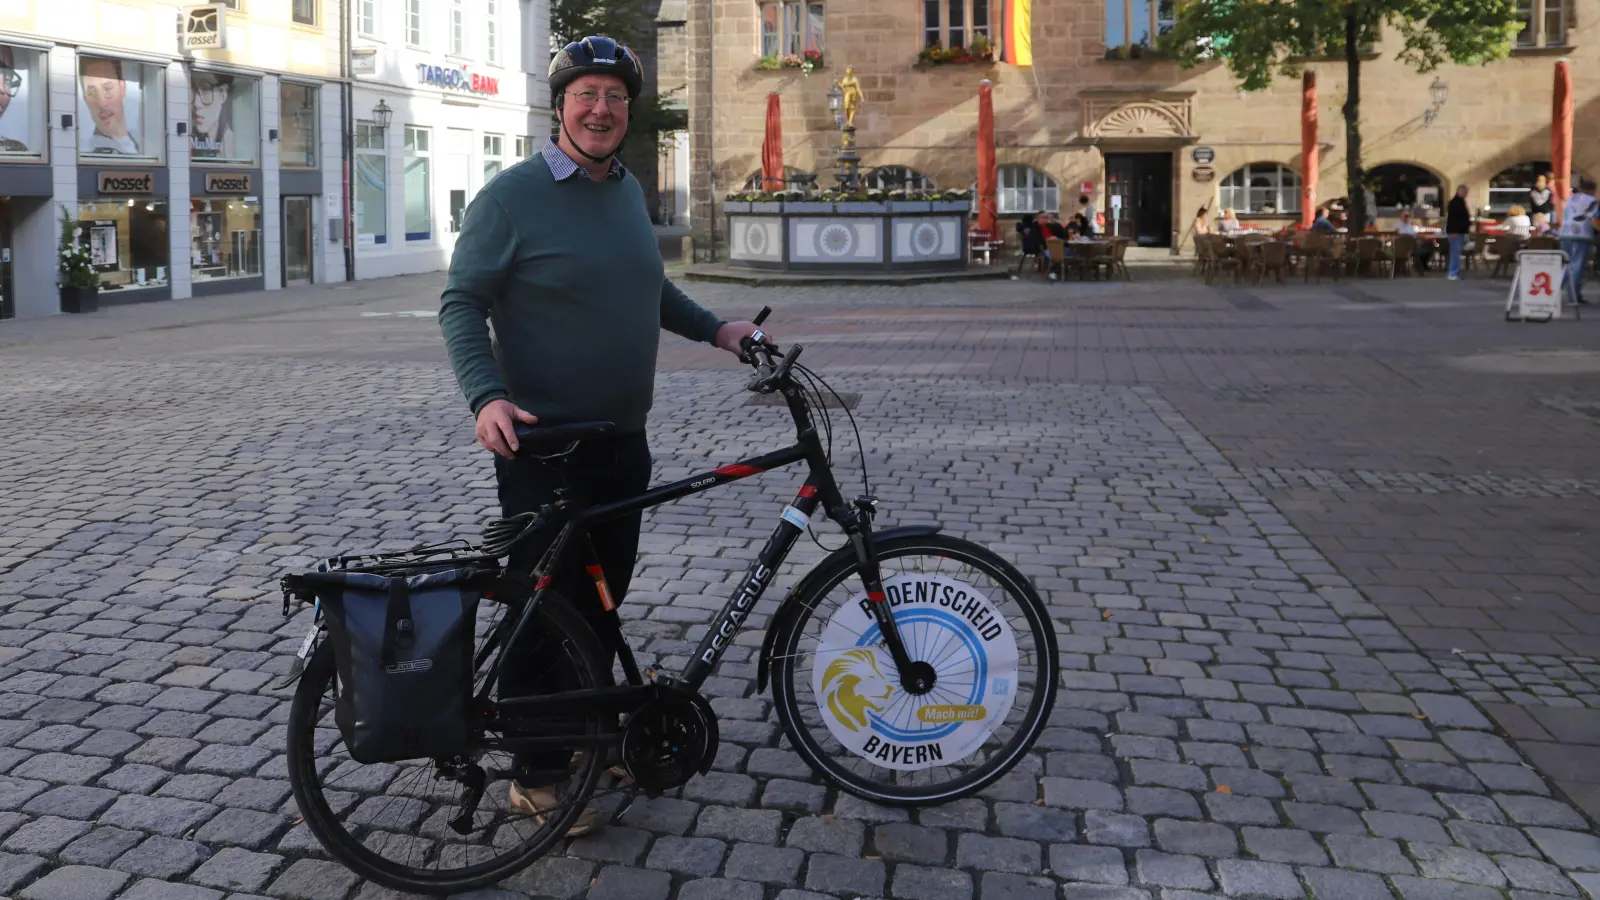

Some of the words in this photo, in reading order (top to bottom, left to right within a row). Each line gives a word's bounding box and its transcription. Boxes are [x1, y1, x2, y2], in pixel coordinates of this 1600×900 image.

[187, 33, 218, 46] rosset
[103, 174, 152, 192] rosset
[210, 176, 249, 191] rosset
[691, 476, 716, 489] SOLERO
[701, 564, 772, 665] PEGASUS
[858, 581, 1002, 642] RDENTSCHEID
[924, 707, 955, 720] Mach
[957, 706, 980, 719] mit!
[862, 735, 943, 764] BAYERN
